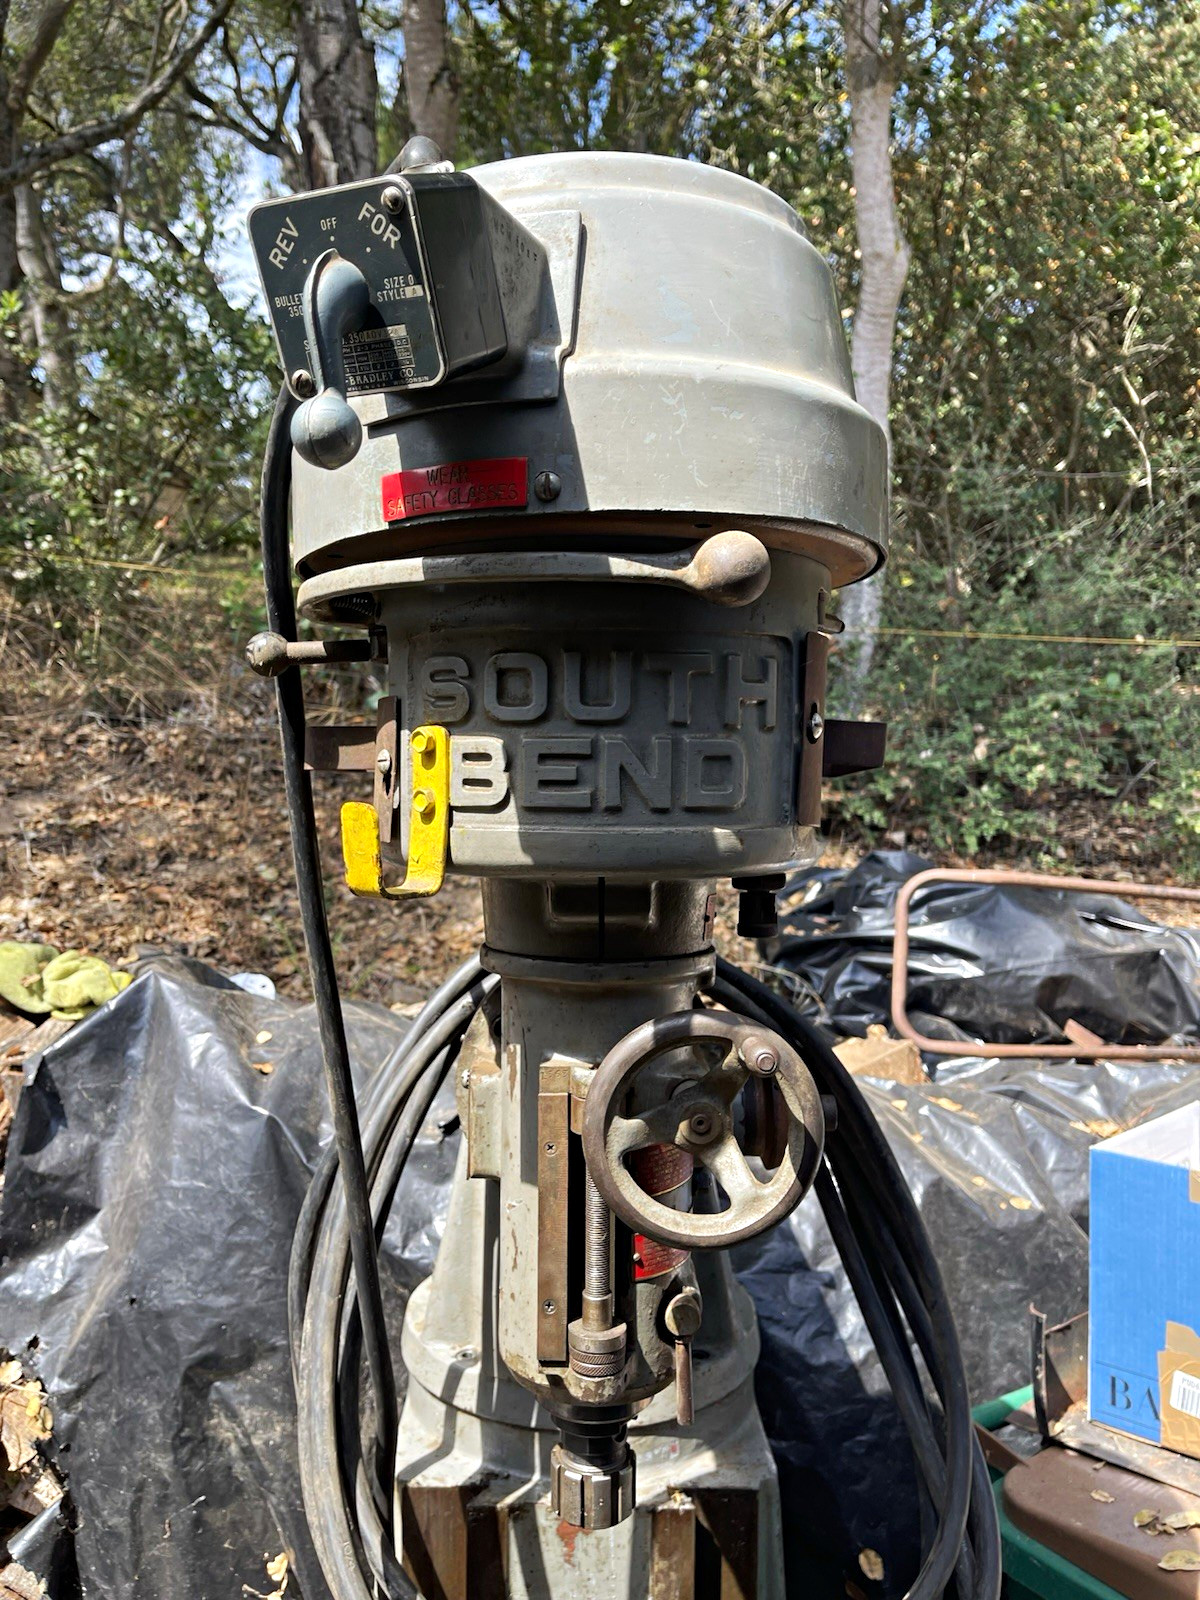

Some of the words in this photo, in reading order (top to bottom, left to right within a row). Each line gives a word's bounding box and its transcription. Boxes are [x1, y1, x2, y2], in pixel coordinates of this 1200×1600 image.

[320, 217, 337, 231] OFF
[357, 202, 402, 250] FOR
[268, 216, 299, 270] REV
[383, 275, 405, 289] SIZE
[274, 292, 304, 308] BULLET
[377, 290, 406, 303] STYLE
[426, 465, 469, 486] WEAR
[387, 491, 438, 515] SAFETY
[421, 649, 778, 729] SOUTH
[450, 735, 748, 810] BEND
[1110, 1375, 1161, 1421] BA
